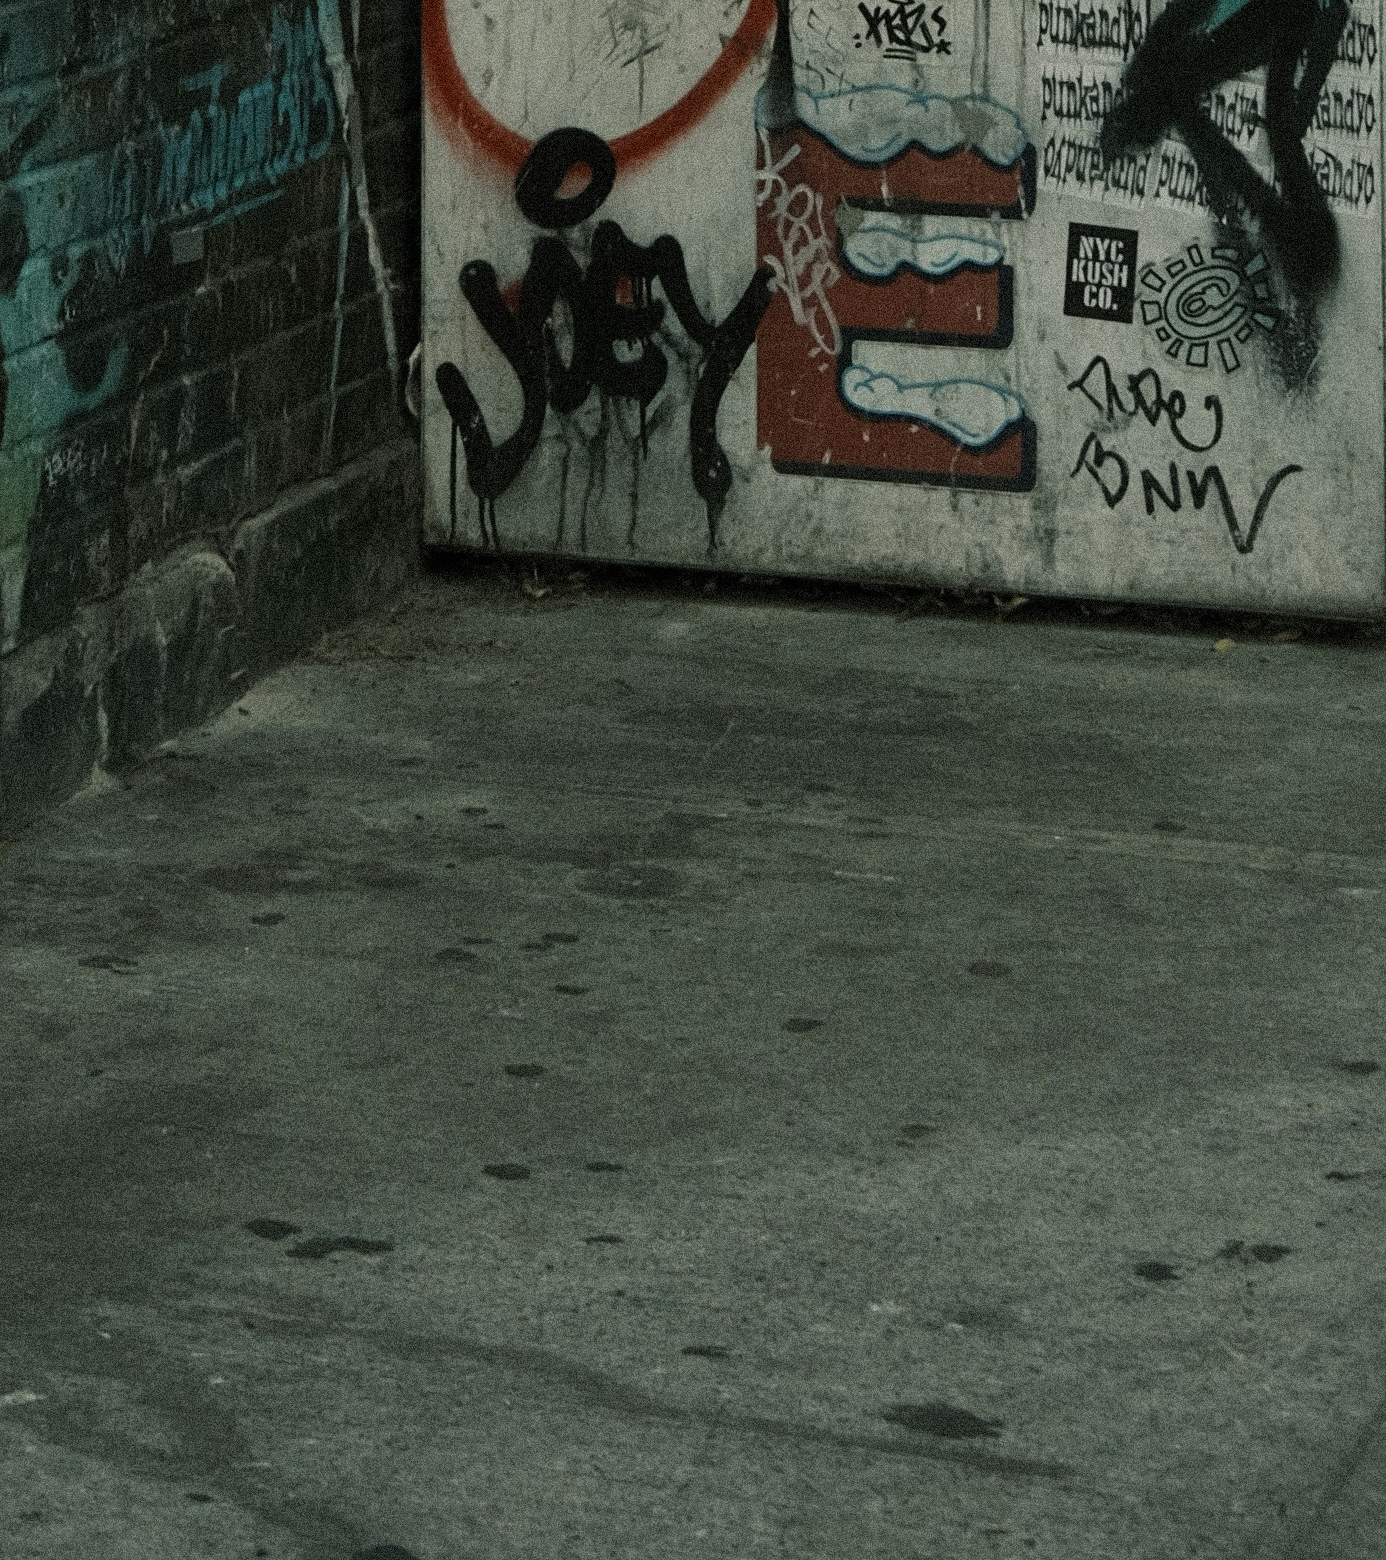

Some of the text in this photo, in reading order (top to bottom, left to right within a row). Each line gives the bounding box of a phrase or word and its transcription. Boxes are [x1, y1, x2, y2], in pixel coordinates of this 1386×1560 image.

[1078, 235, 1125, 263] NYC
[1070, 260, 1129, 288] KUSH
[1082, 284, 1120, 312] CO.
